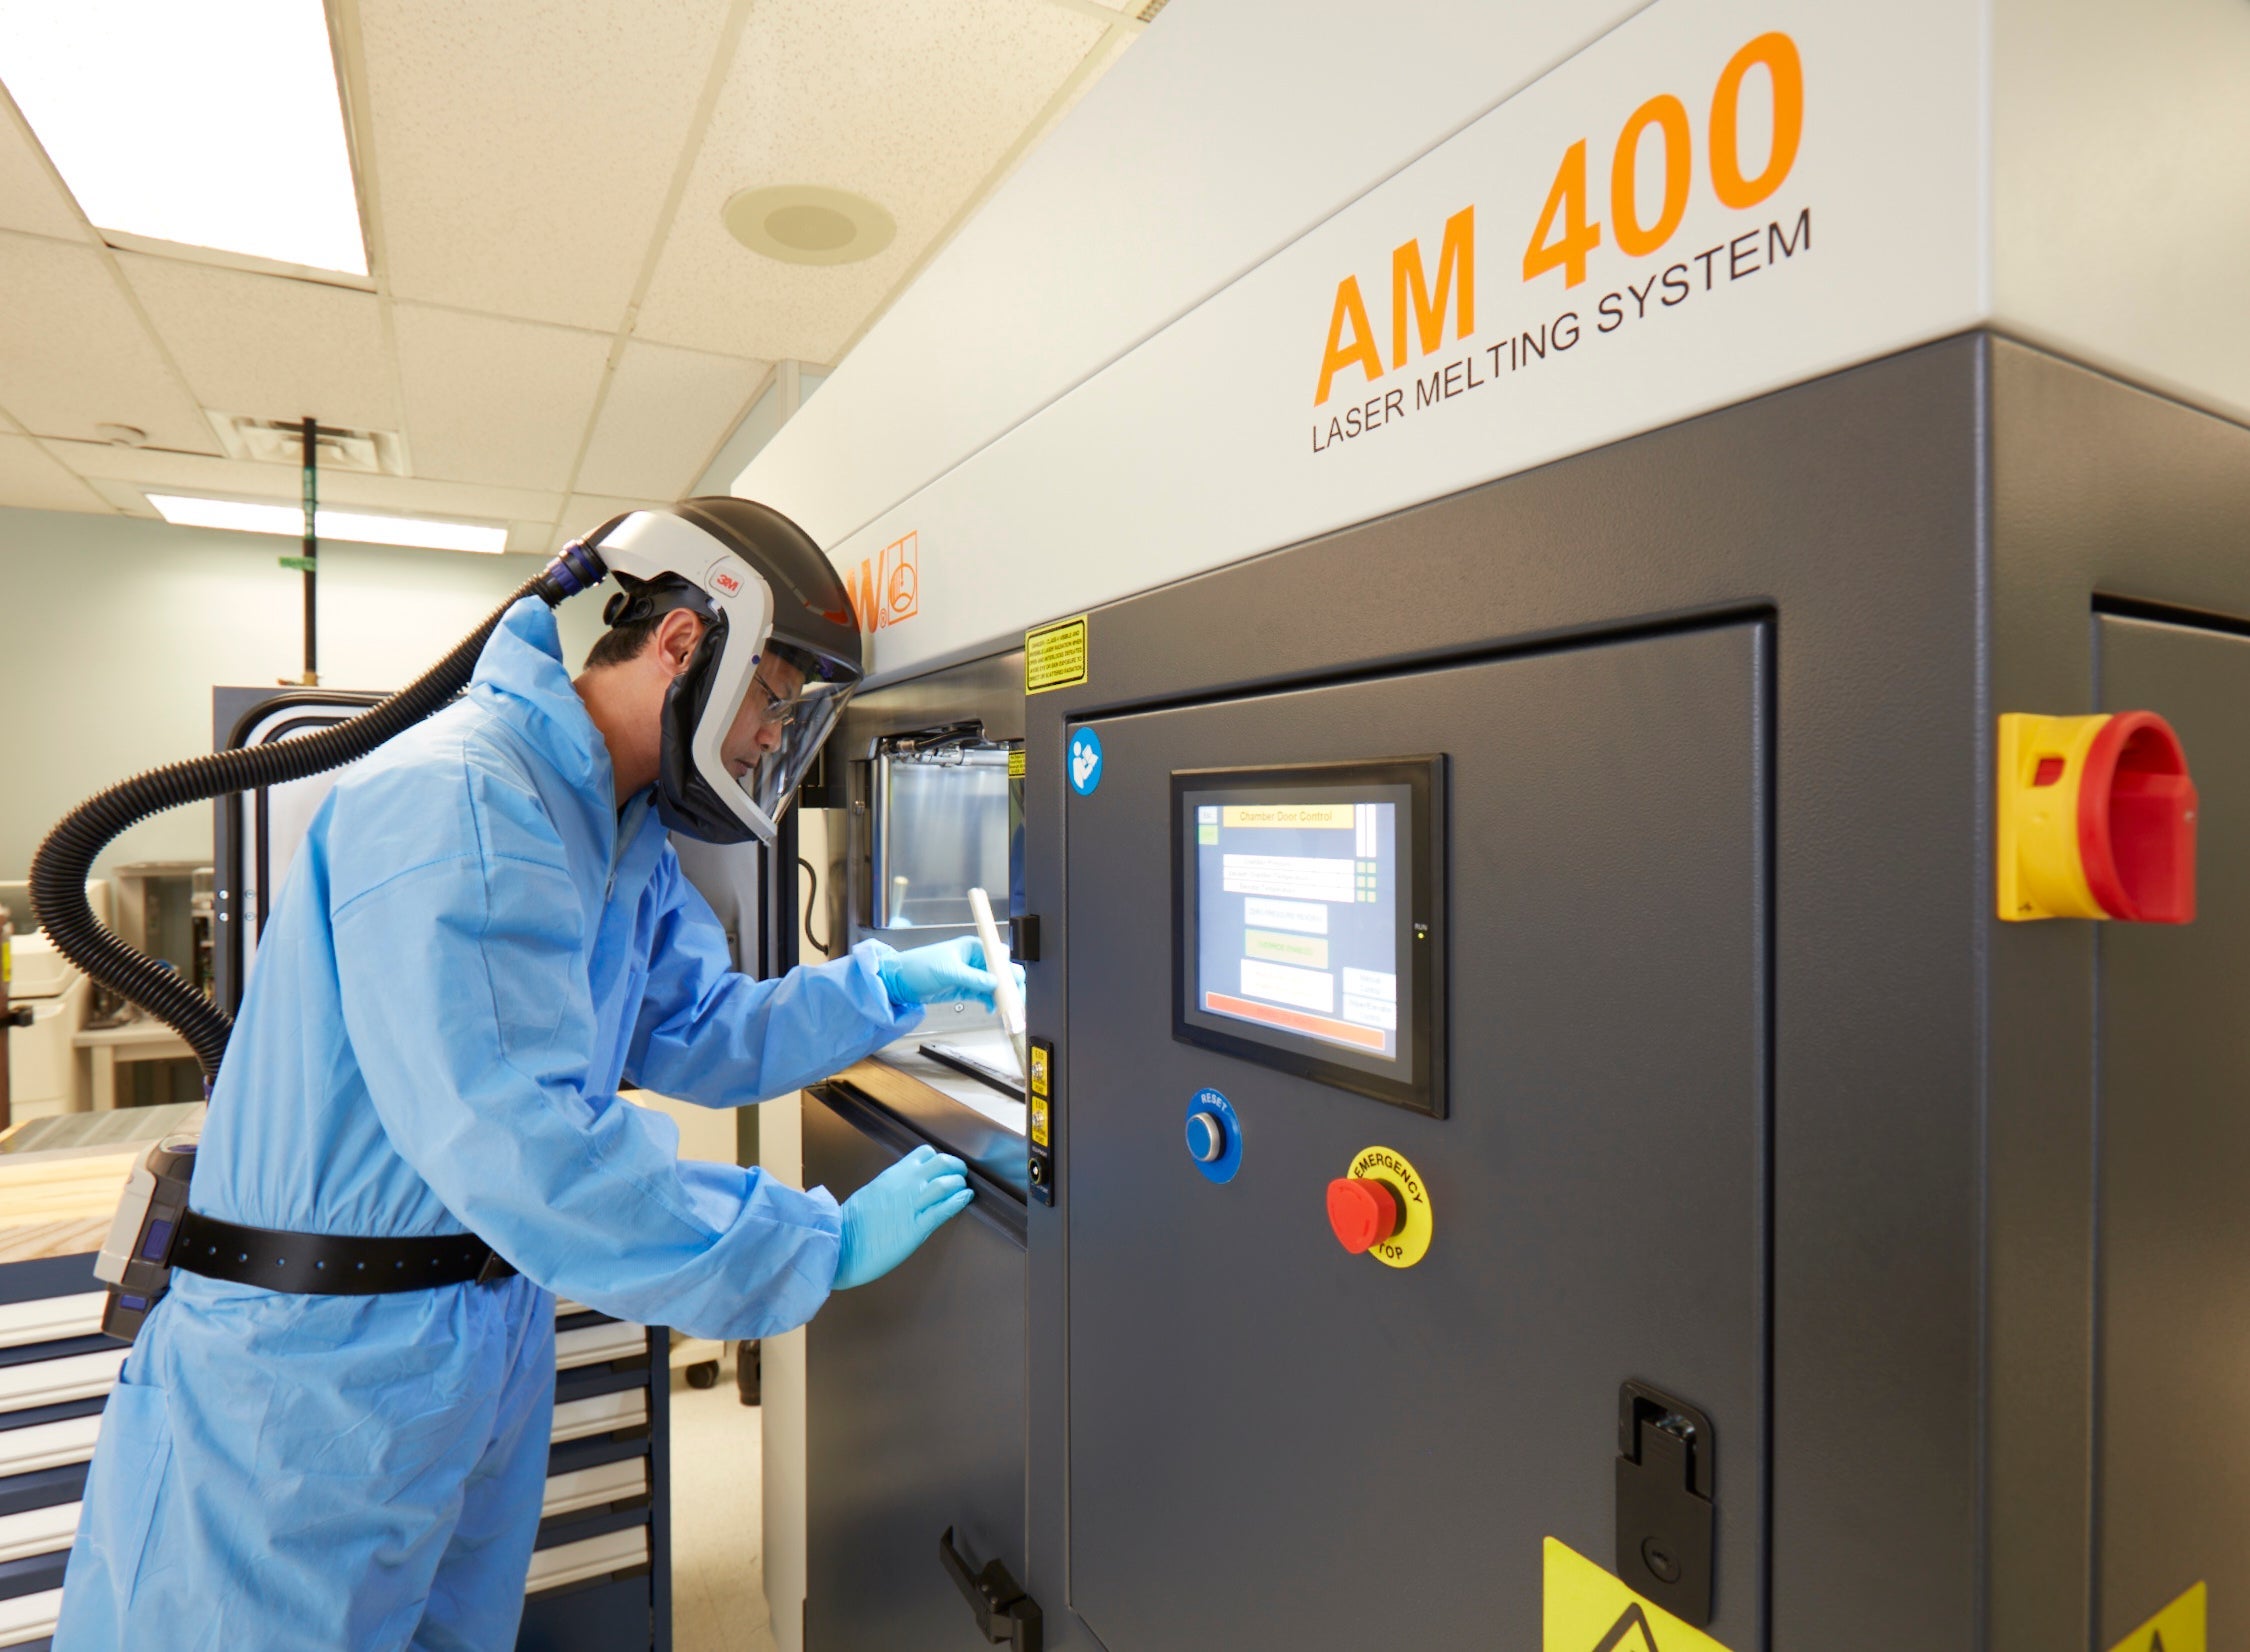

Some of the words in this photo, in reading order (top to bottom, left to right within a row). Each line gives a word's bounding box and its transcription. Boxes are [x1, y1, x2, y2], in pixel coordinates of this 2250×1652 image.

[1314, 205, 1474, 406] AM
[1523, 31, 1804, 290] 400
[1313, 389, 1406, 453] LASER
[1416, 313, 1580, 411] MELTING
[1597, 207, 1812, 334] SYSTEM
[716, 574, 739, 591] 3M
[1239, 811, 1275, 822] Chamber
[1277, 811, 1298, 822] Door
[1299, 811, 1333, 822] Control
[1414, 922, 1428, 931] RUN
[1201, 1092, 1228, 1112] RESET
[1354, 1152, 1424, 1205] EMERGENCY
[1378, 1243, 1403, 1260] TOP
